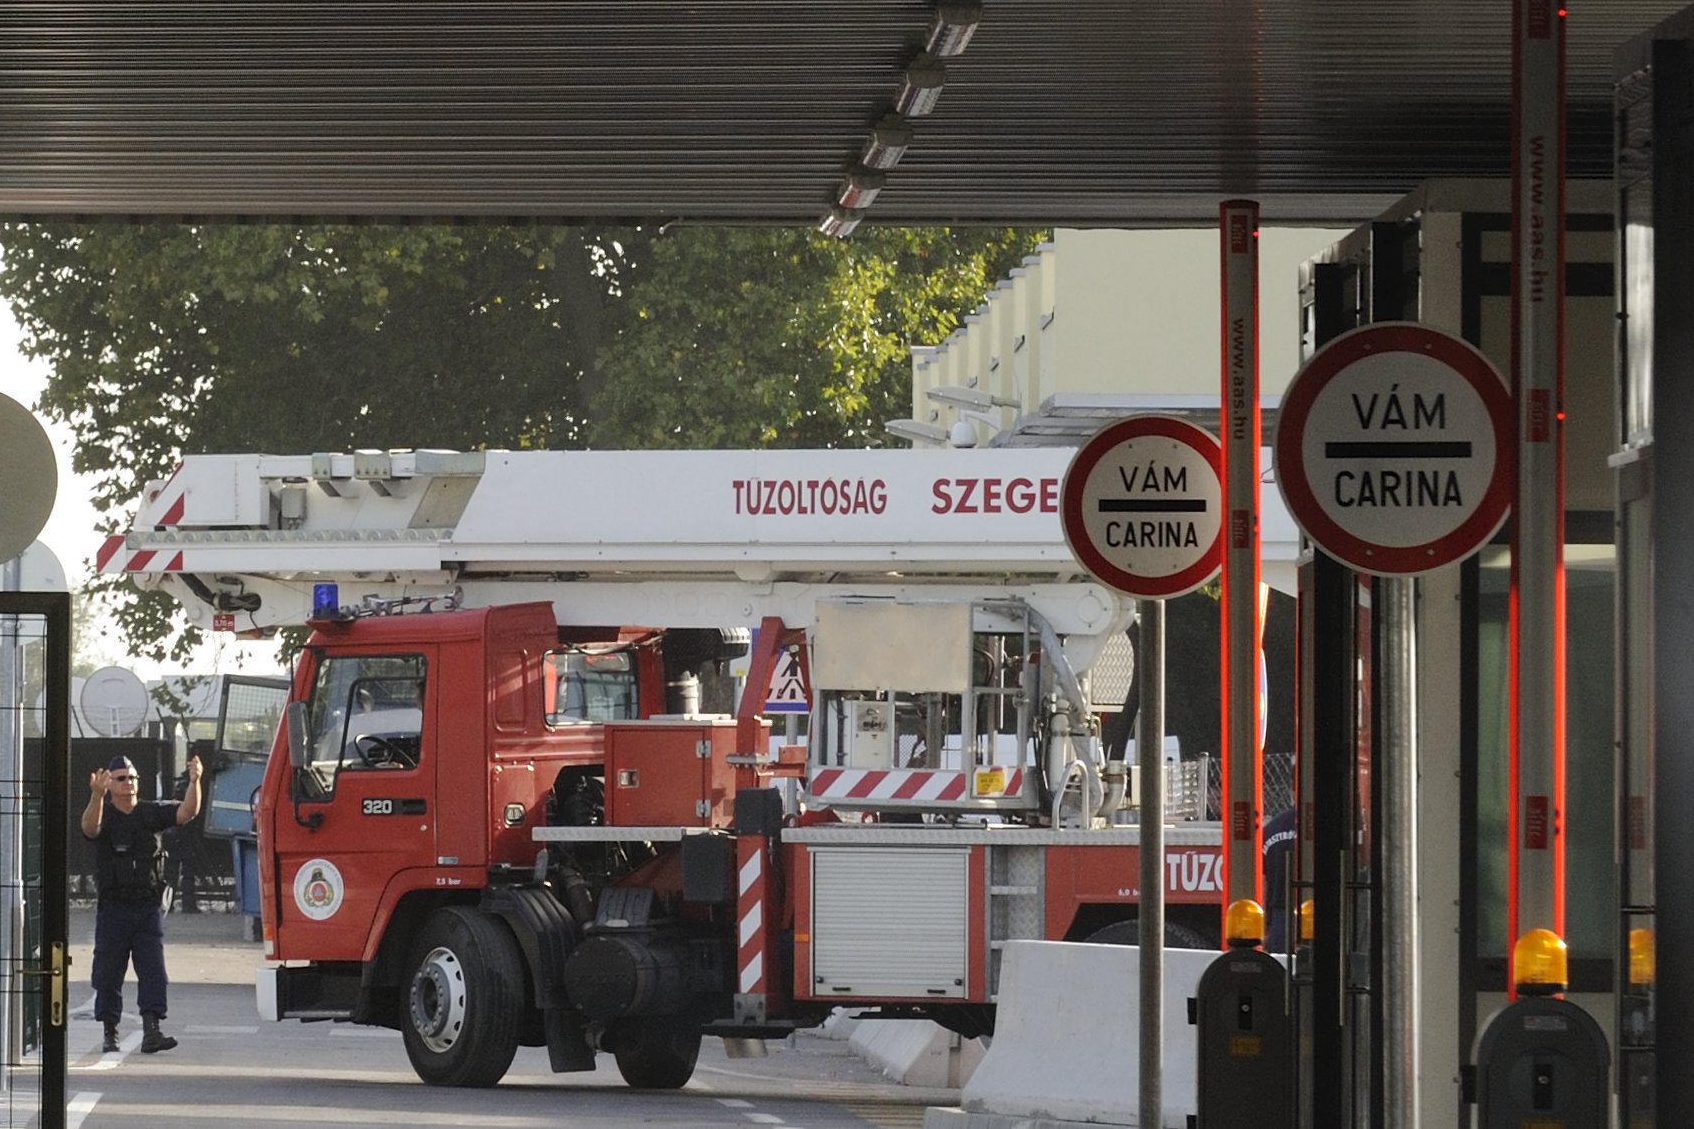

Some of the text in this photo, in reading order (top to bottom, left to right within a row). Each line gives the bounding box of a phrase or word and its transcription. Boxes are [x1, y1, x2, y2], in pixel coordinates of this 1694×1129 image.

[1529, 135, 1549, 302] www.aas.hu
[1232, 317, 1247, 440] www.aas.hu
[1350, 382, 1446, 431] VÁM
[1118, 459, 1188, 494] VÁM
[1333, 470, 1463, 509] CARINA
[931, 477, 1059, 516] SZEGE
[1105, 519, 1200, 550] CARINA
[363, 800, 392, 814] 320
